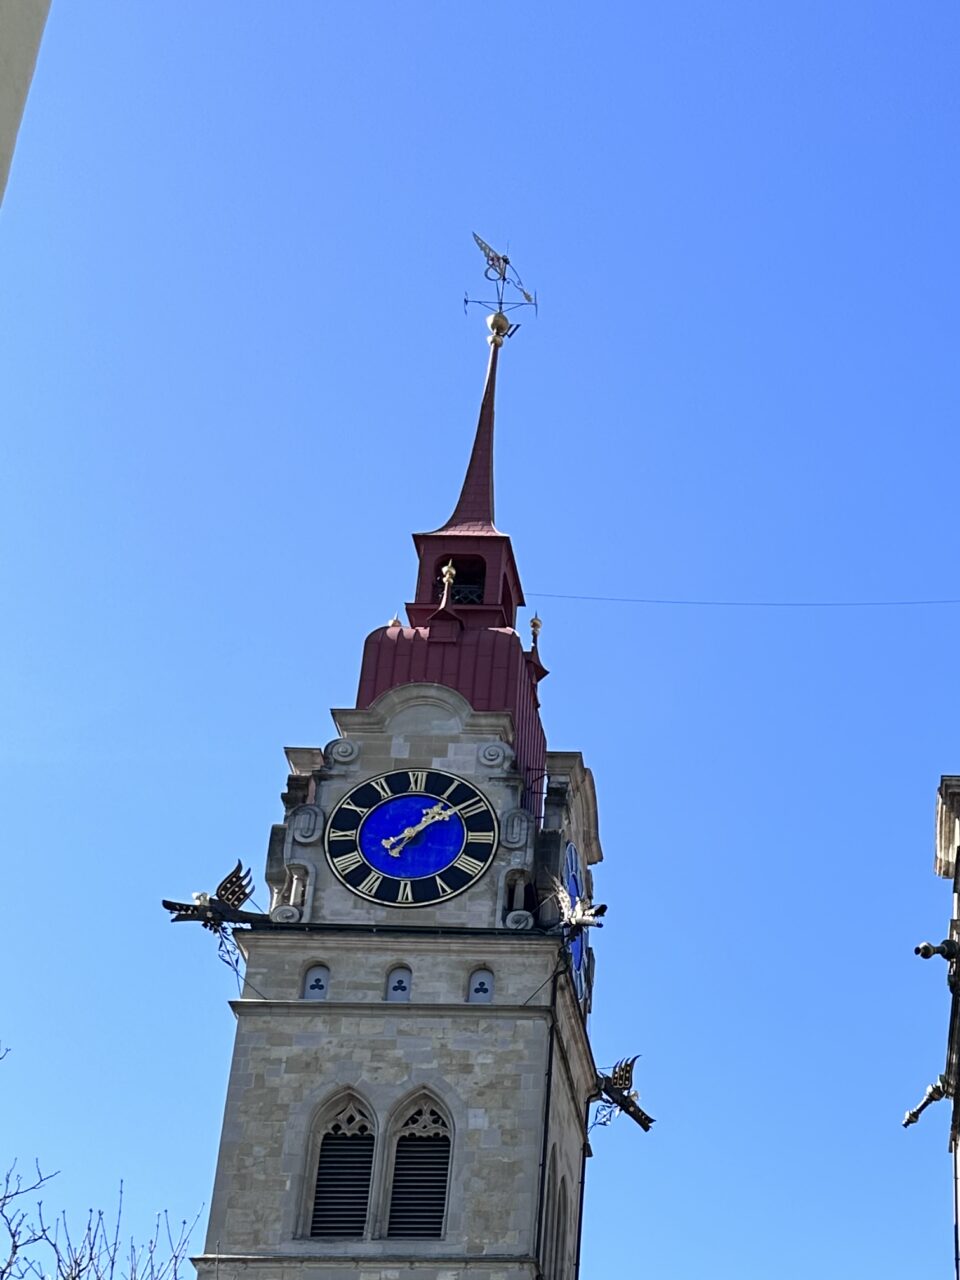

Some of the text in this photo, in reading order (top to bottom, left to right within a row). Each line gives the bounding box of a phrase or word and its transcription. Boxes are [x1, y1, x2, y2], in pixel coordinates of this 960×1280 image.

[370, 778, 394, 799] XI
[408, 772, 428, 792] XII
[441, 780, 461, 798] I
[342, 799, 369, 816] X
[329, 828, 357, 841] IX
[467, 831, 494, 843] III
[333, 851, 363, 876] VIII
[454, 853, 485, 877] IIII
[357, 871, 383, 896] VII
[396, 880, 414, 903] VI
[435, 875, 453, 896] V
